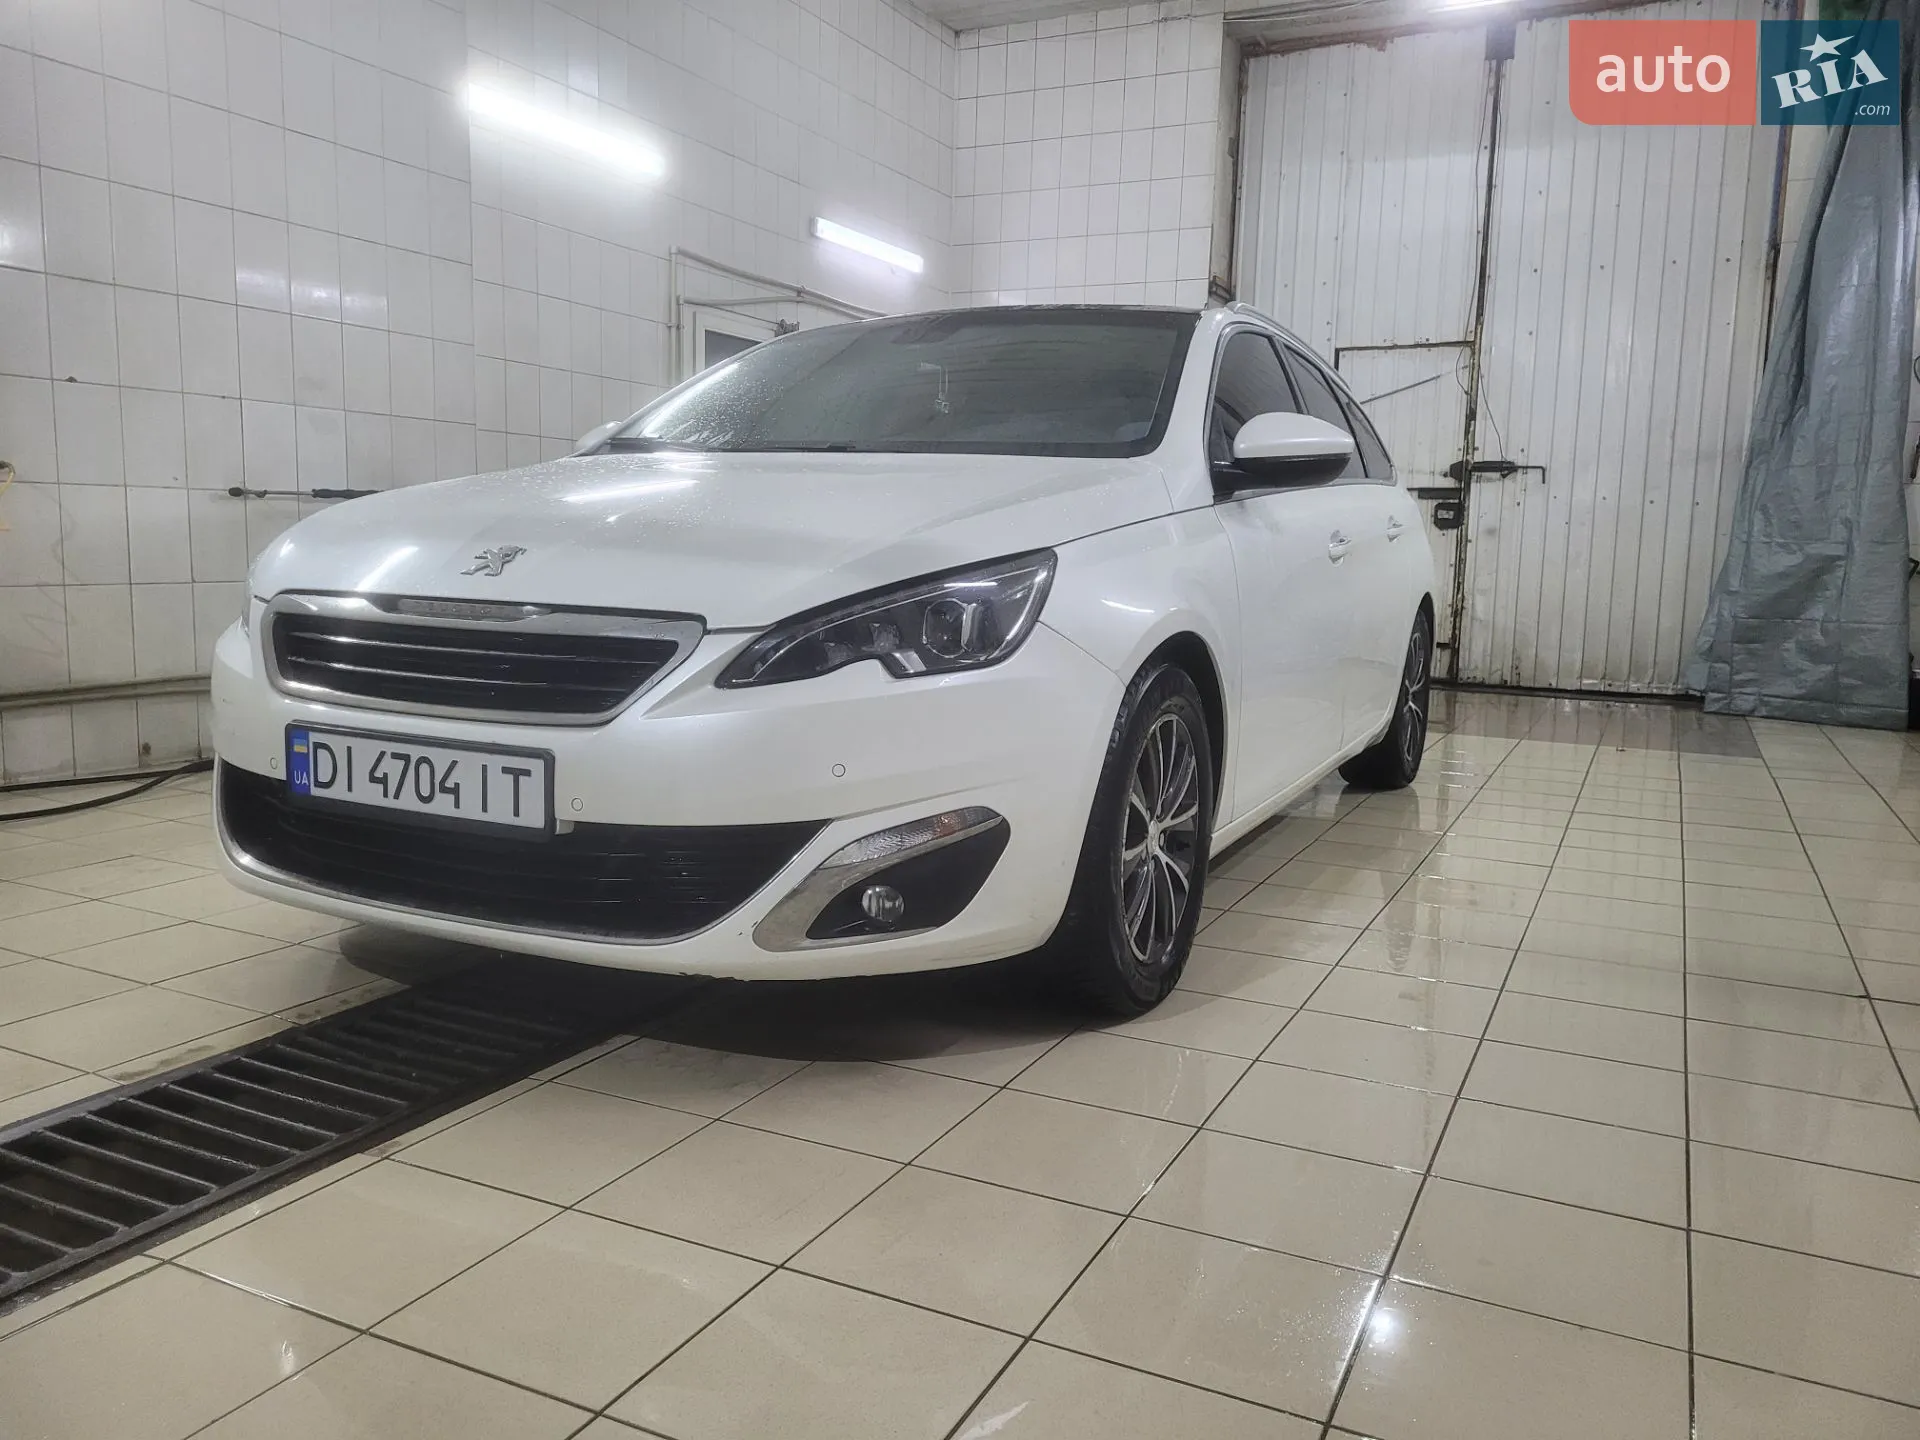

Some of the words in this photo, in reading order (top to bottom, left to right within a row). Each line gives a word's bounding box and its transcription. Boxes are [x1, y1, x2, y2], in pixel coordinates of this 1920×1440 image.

[294, 770, 309, 786] UA
[313, 741, 353, 793] DI
[368, 750, 460, 809] 4704
[481, 764, 532, 818] IT
